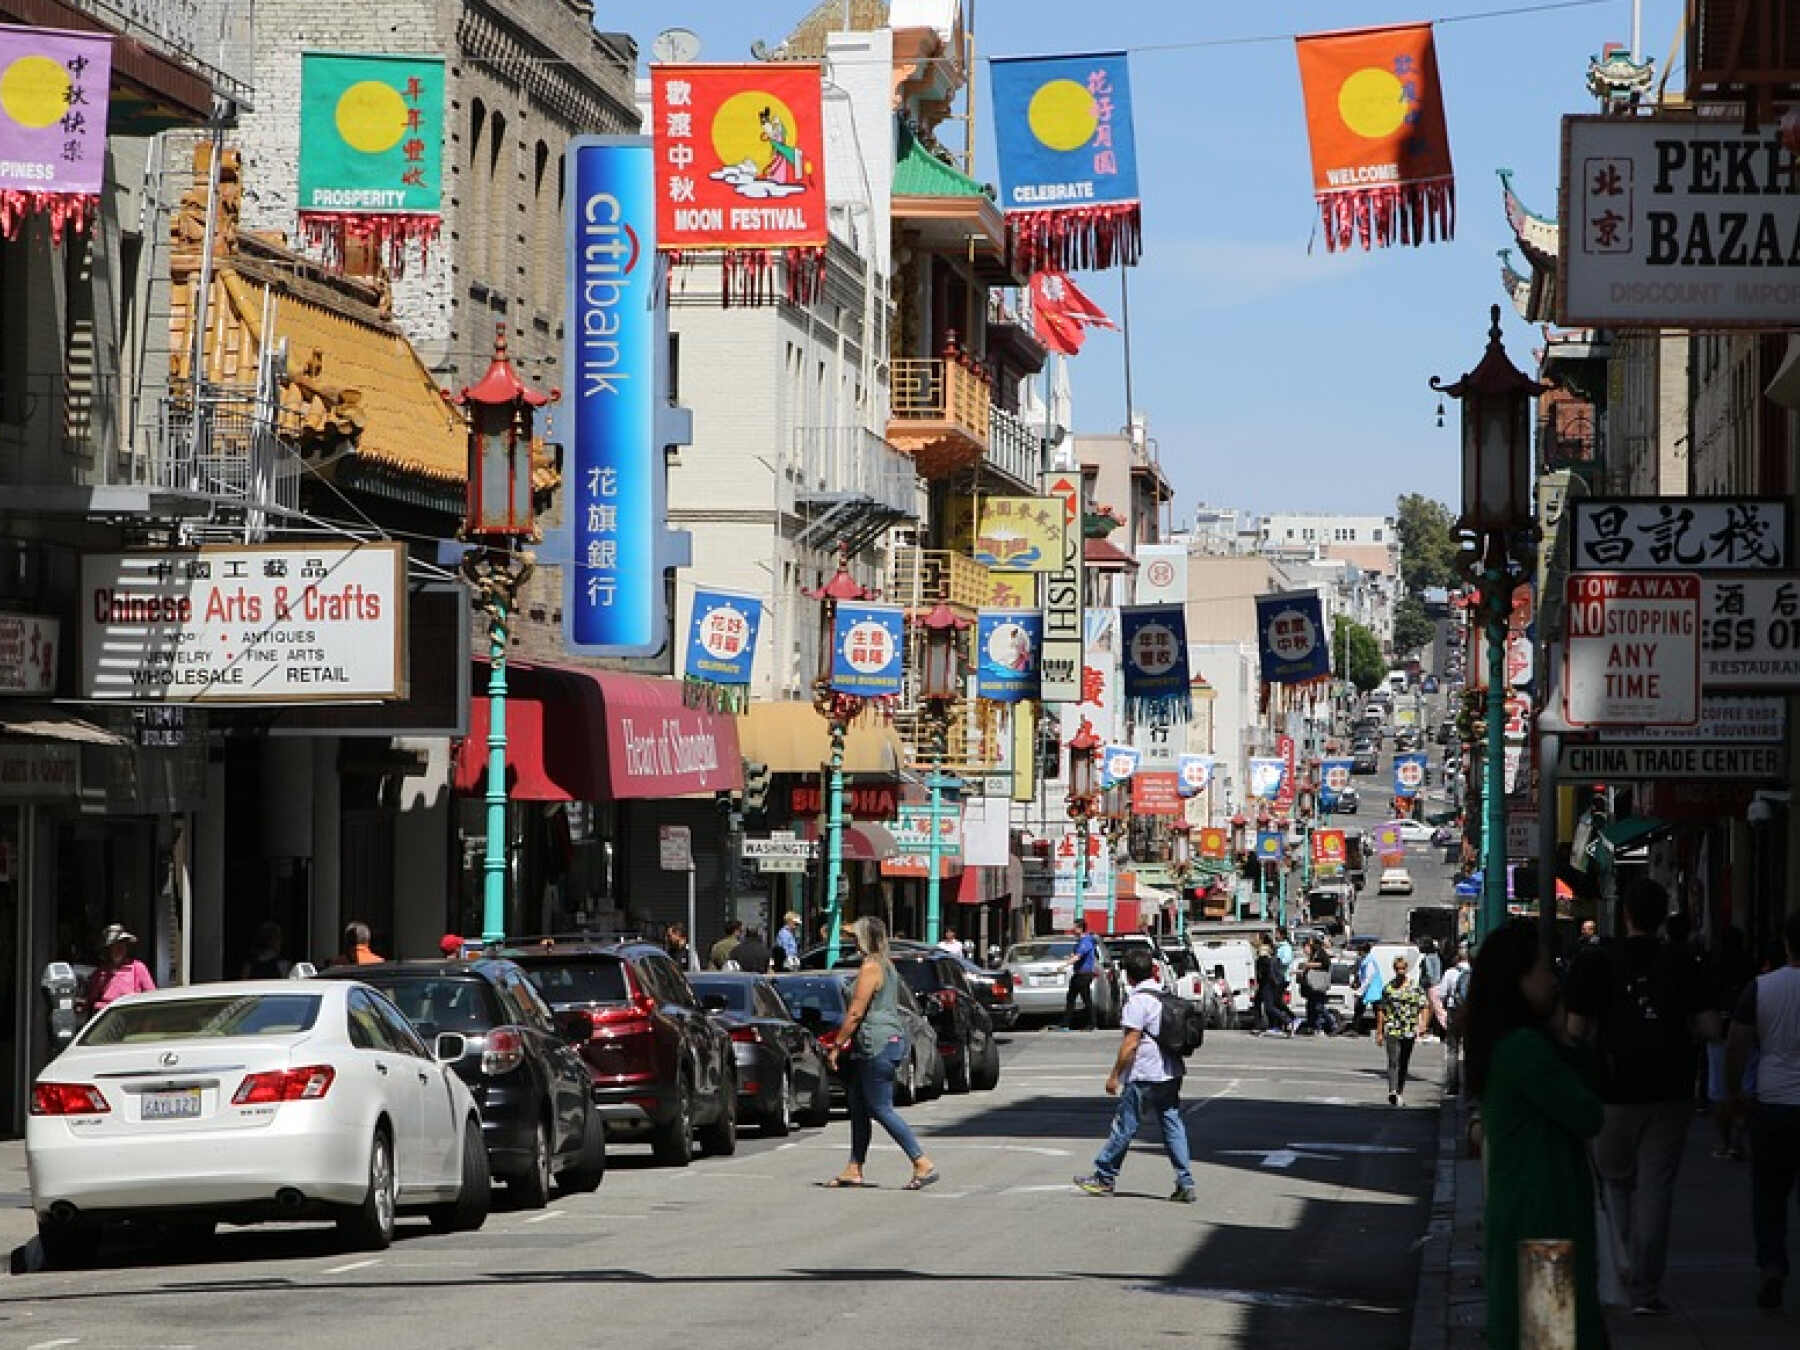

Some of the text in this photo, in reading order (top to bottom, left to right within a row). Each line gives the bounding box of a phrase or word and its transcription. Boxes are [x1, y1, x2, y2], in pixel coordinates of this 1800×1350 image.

[1326, 164, 1399, 186] WELCOME
[312, 190, 406, 206] PROSPERITY
[1012, 181, 1095, 203] CELEBRATE
[1590, 164, 1626, 248] 北京
[674, 208, 807, 231] MOON FESTIVAL
[582, 191, 631, 398] citibank
[1610, 282, 1723, 303] DISCOUNT
[586, 466, 618, 607] 花旗銀行
[1575, 579, 1691, 597] TOW-AWAY
[94, 584, 381, 623] Chinese Arts & Crafts
[1569, 601, 1694, 636] NO STOPPING
[242, 630, 316, 643] ANTIQUES
[147, 648, 325, 664] JEWELRY FINE ARTS
[1607, 643, 1658, 669] ANY
[130, 667, 349, 685] WHOLESALE RETAIL
[1604, 674, 1662, 699] TIME
[1570, 750, 1778, 774] CHINA TRADE CENTER
